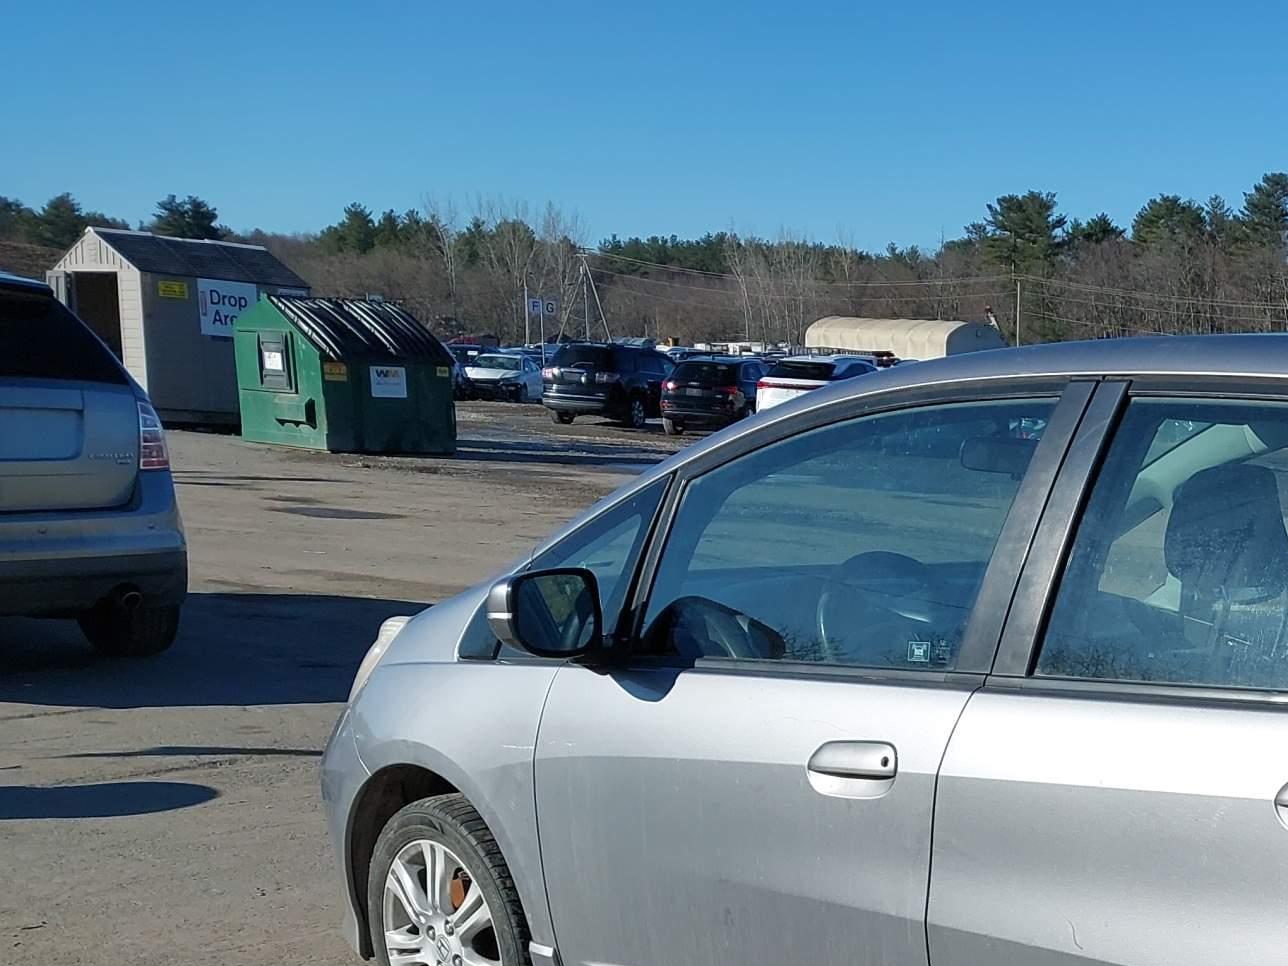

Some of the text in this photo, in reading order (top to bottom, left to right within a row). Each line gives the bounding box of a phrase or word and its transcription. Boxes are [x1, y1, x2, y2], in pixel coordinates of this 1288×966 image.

[209, 289, 248, 311] Drop
[532, 301, 540, 311] F
[546, 302, 554, 313] G
[212, 309, 237, 326] Are
